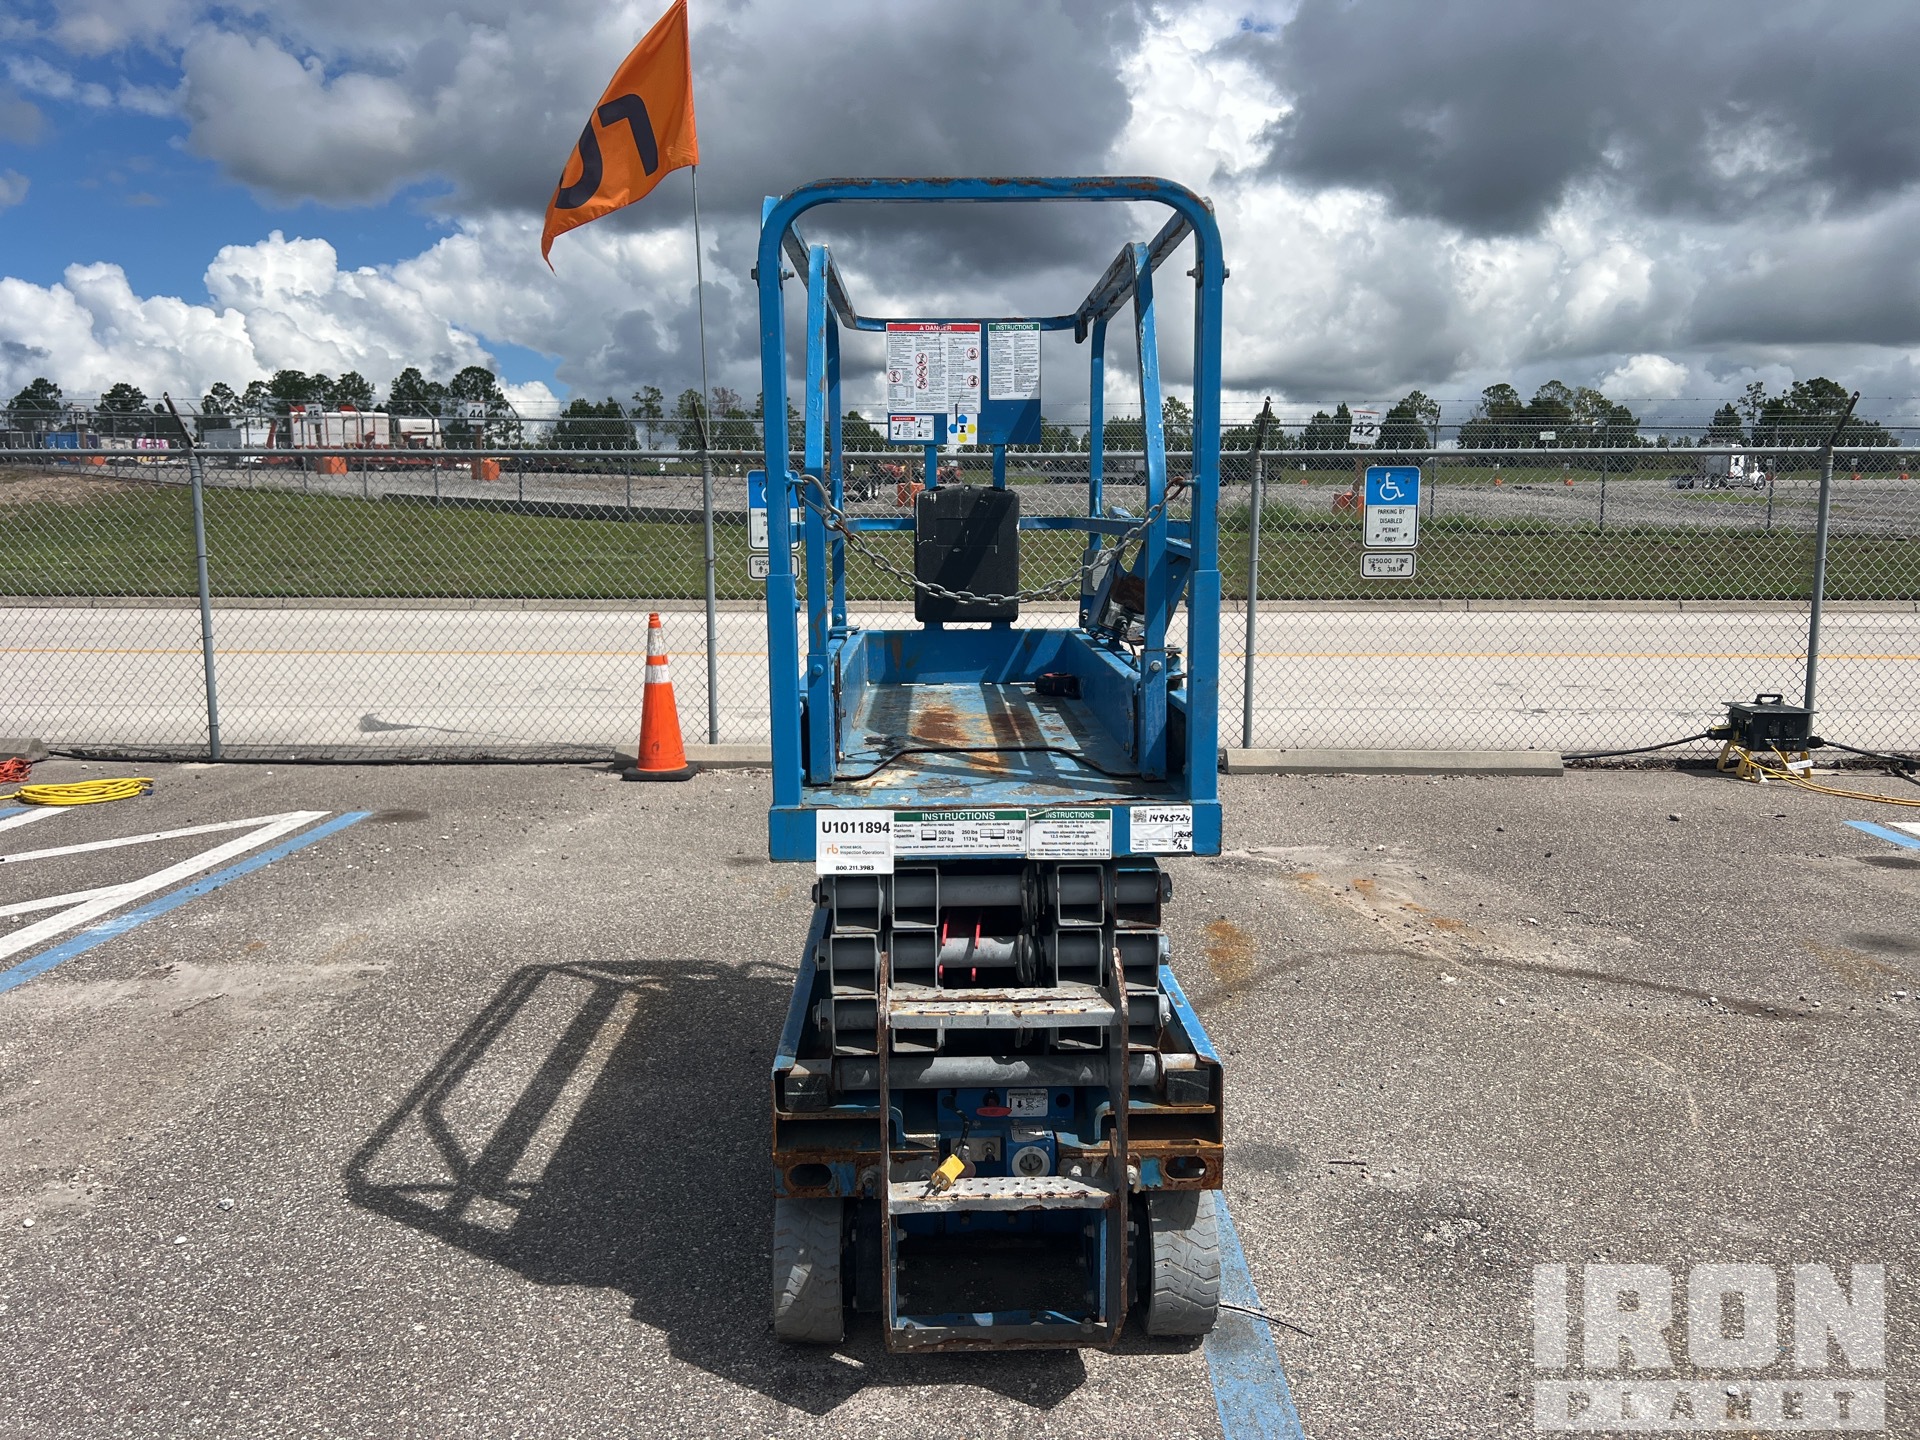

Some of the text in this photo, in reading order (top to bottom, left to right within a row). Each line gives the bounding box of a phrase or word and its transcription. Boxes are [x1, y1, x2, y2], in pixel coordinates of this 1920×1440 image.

[469, 409, 483, 418] 44
[1353, 421, 1375, 437] 42
[921, 811, 996, 821] INSTRUCTIONS
[1045, 811, 1095, 819] INSTRUCTIONS
[1149, 813, 1191, 824] 14965724
[821, 821, 891, 834] U1011894
[826, 843, 839, 855] rb
